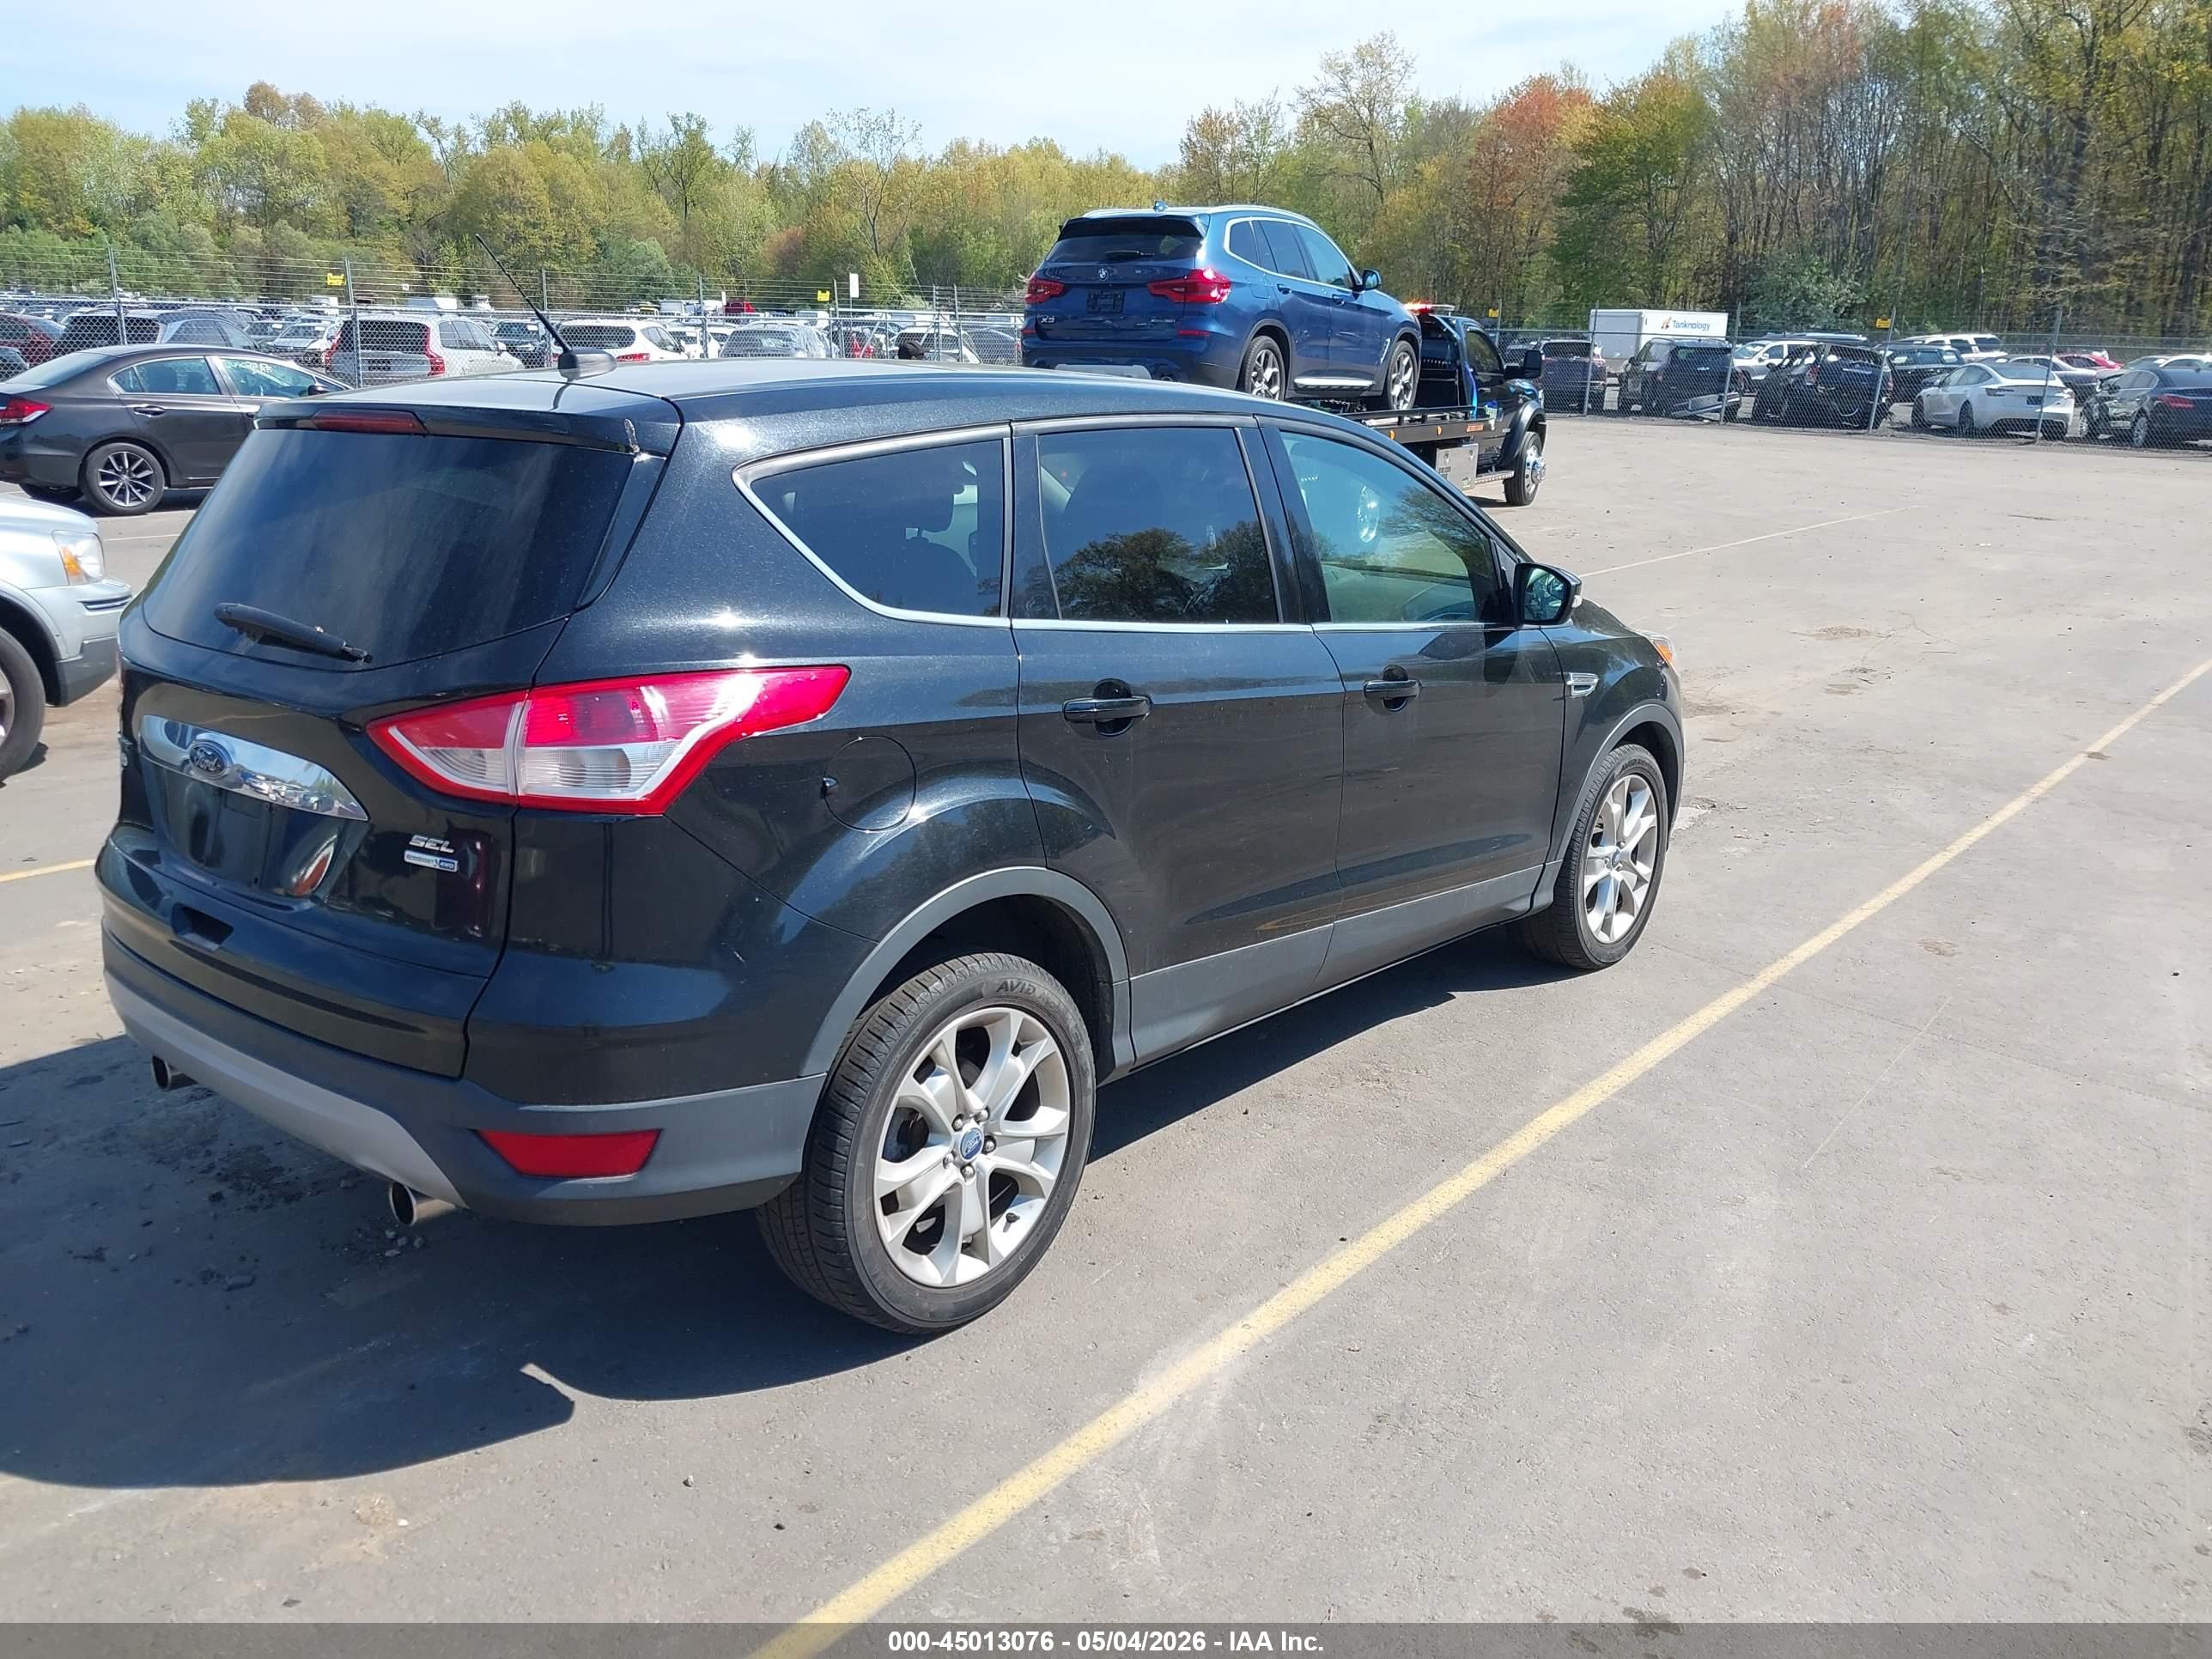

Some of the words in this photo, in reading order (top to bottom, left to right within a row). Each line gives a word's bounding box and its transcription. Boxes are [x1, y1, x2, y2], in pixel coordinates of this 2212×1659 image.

[1672, 320, 1711, 331] Tanknology
[409, 836, 455, 854] SEL
[996, 980, 1036, 994] AVID
